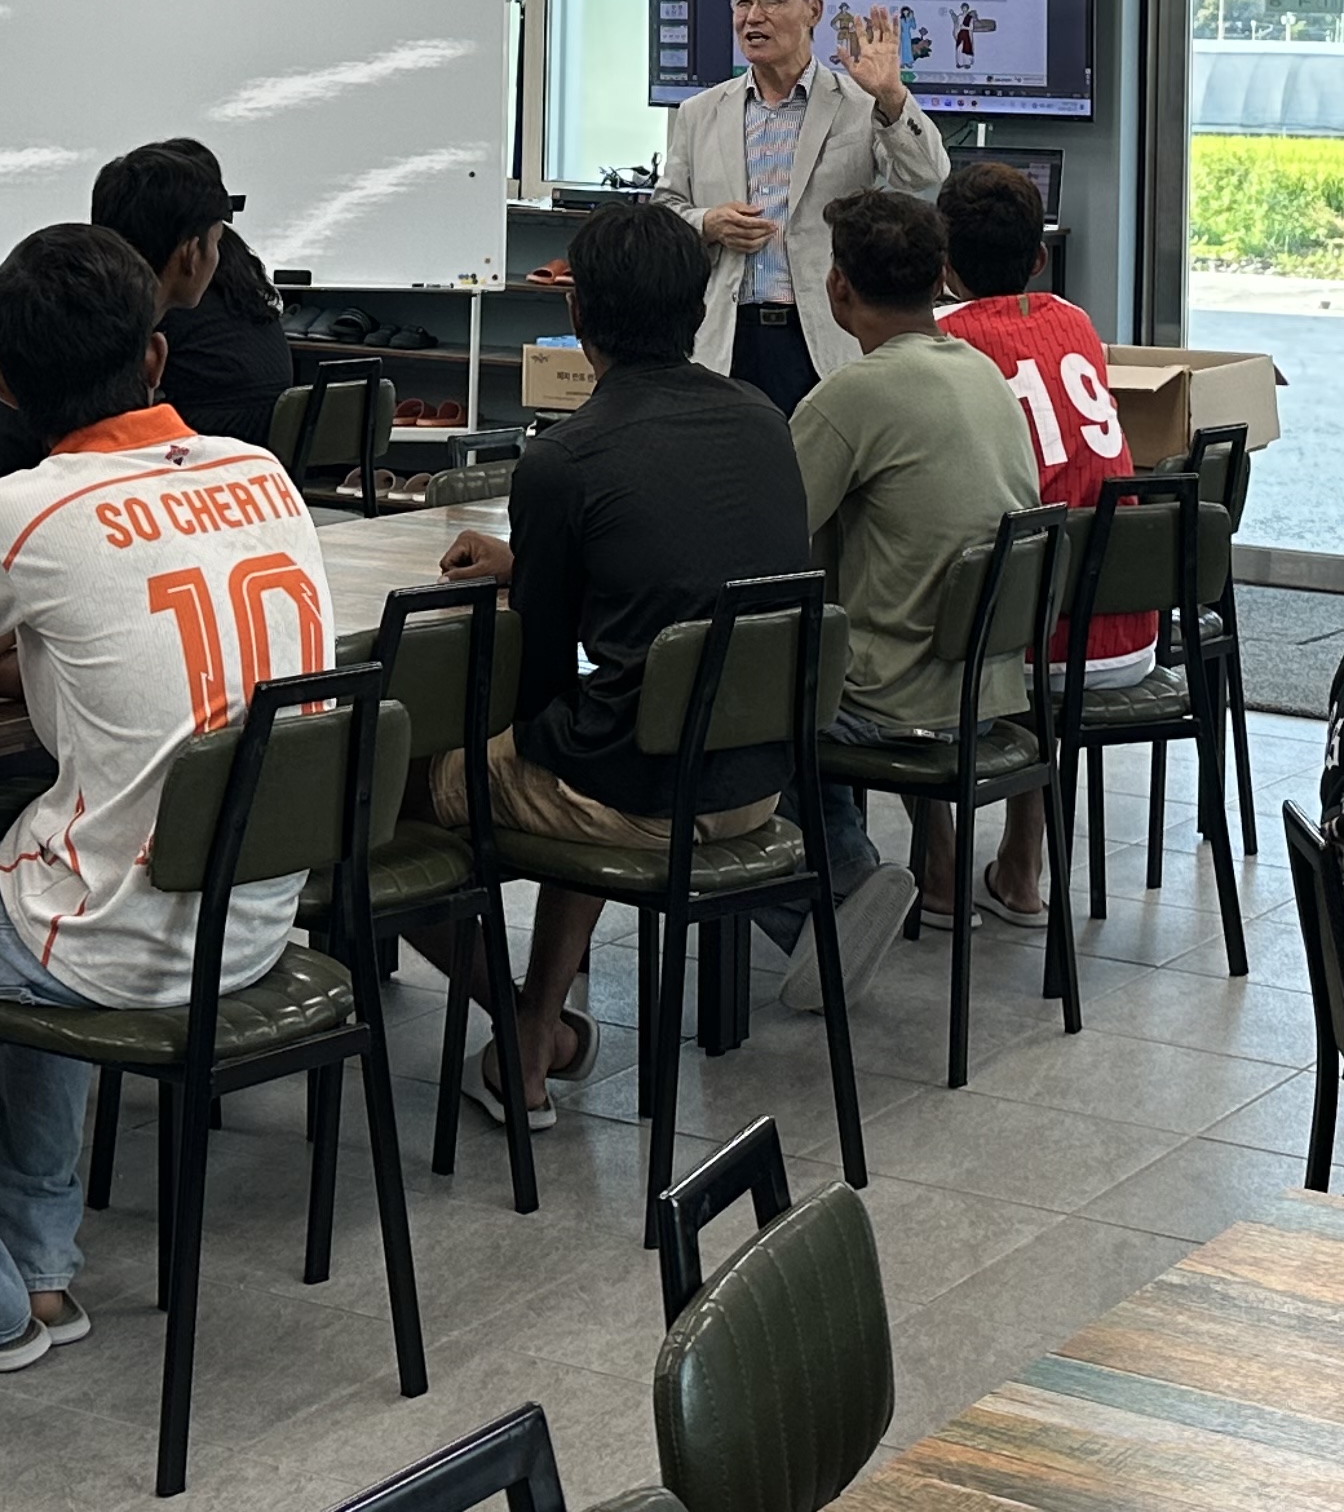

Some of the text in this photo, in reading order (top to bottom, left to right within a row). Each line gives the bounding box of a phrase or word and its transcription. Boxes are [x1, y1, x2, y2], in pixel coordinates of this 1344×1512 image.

[1006, 352, 1123, 466] 19
[95, 497, 162, 549] SO
[147, 551, 325, 737] 10
